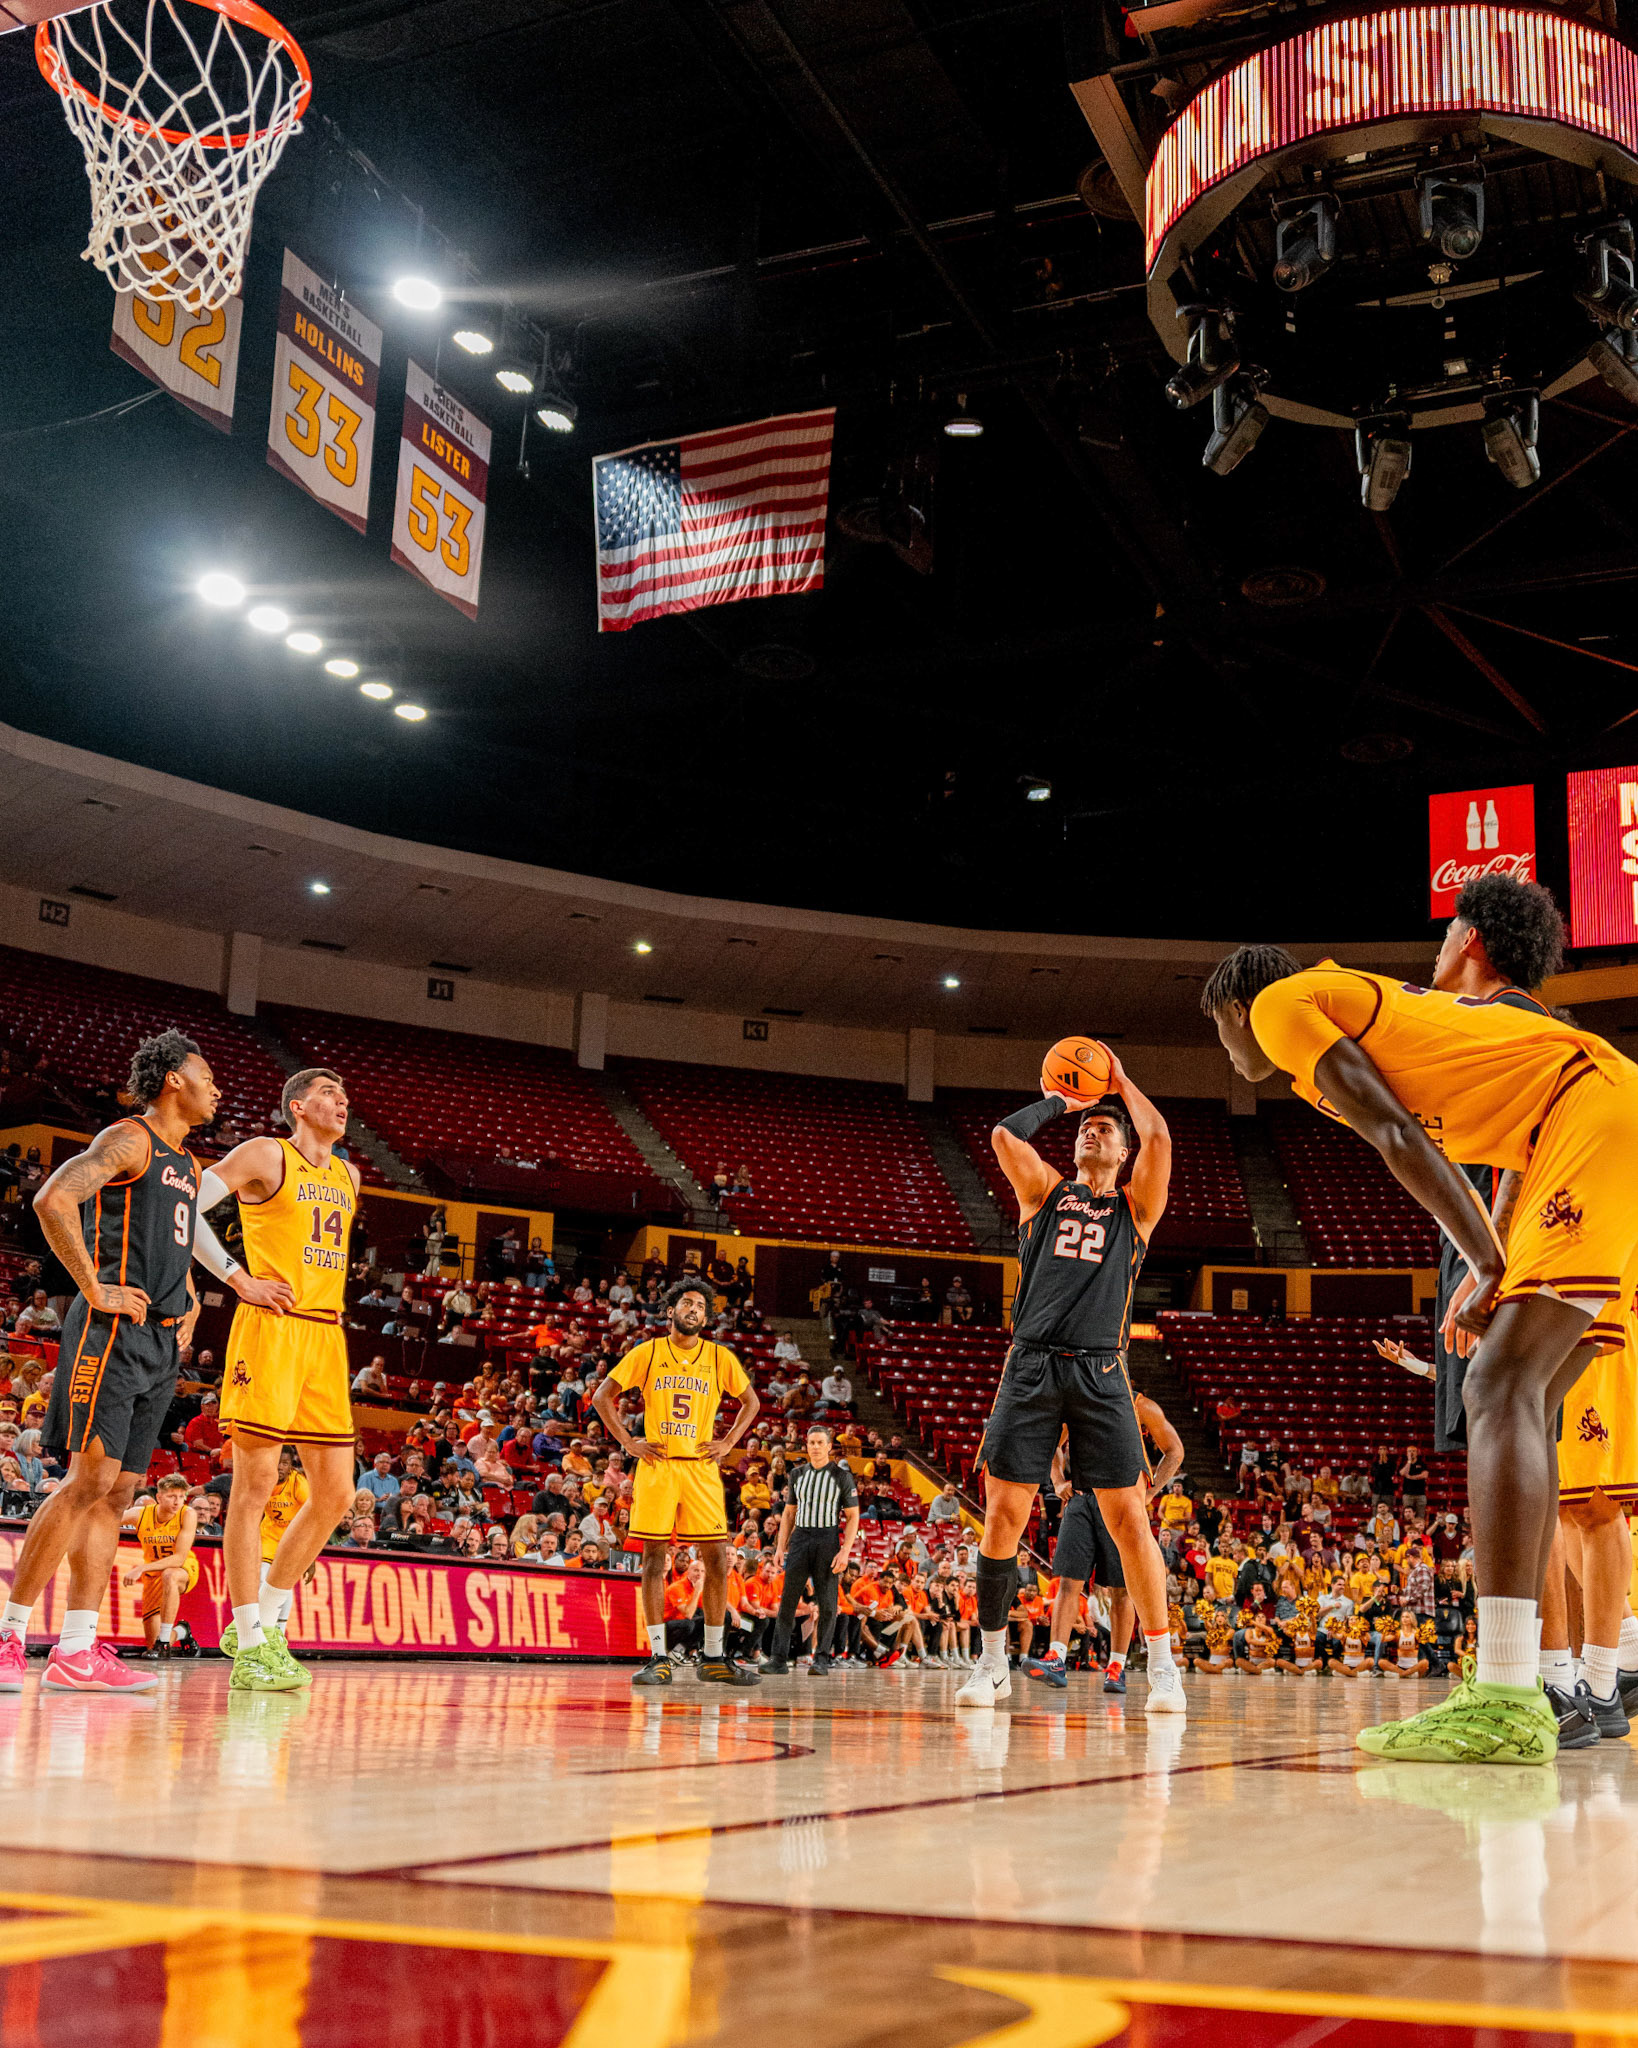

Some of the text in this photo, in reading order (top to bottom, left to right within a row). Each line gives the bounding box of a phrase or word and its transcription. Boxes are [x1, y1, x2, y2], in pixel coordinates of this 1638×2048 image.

[303, 286, 362, 348] BASKETBALL
[294, 312, 365, 386] HOLLINS
[285, 360, 362, 488] 33
[423, 393, 474, 447] BASKETBALL
[421, 422, 471, 480] LISTER
[408, 463, 473, 576] 53
[1431, 852, 1535, 892] Coca-Cla
[42, 903, 67, 922] H2
[433, 982, 449, 997] J1
[747, 1023, 765, 1037] K1
[296, 1183, 353, 1215] ARIZONA
[1056, 1194, 1114, 1220] Cowboys
[174, 1201, 190, 1248] 9
[311, 1206, 343, 1248] 14
[1054, 1219, 1106, 1263] 22
[72, 1355, 100, 1404] POKES
[654, 1375, 709, 1396] ARIZONA
[672, 1393, 692, 1420] 5
[660, 1421, 698, 1439] STATE
[272, 1509, 285, 1521] 2
[143, 1535, 175, 1545] ARIZON
[153, 1545, 174, 1560] 15
